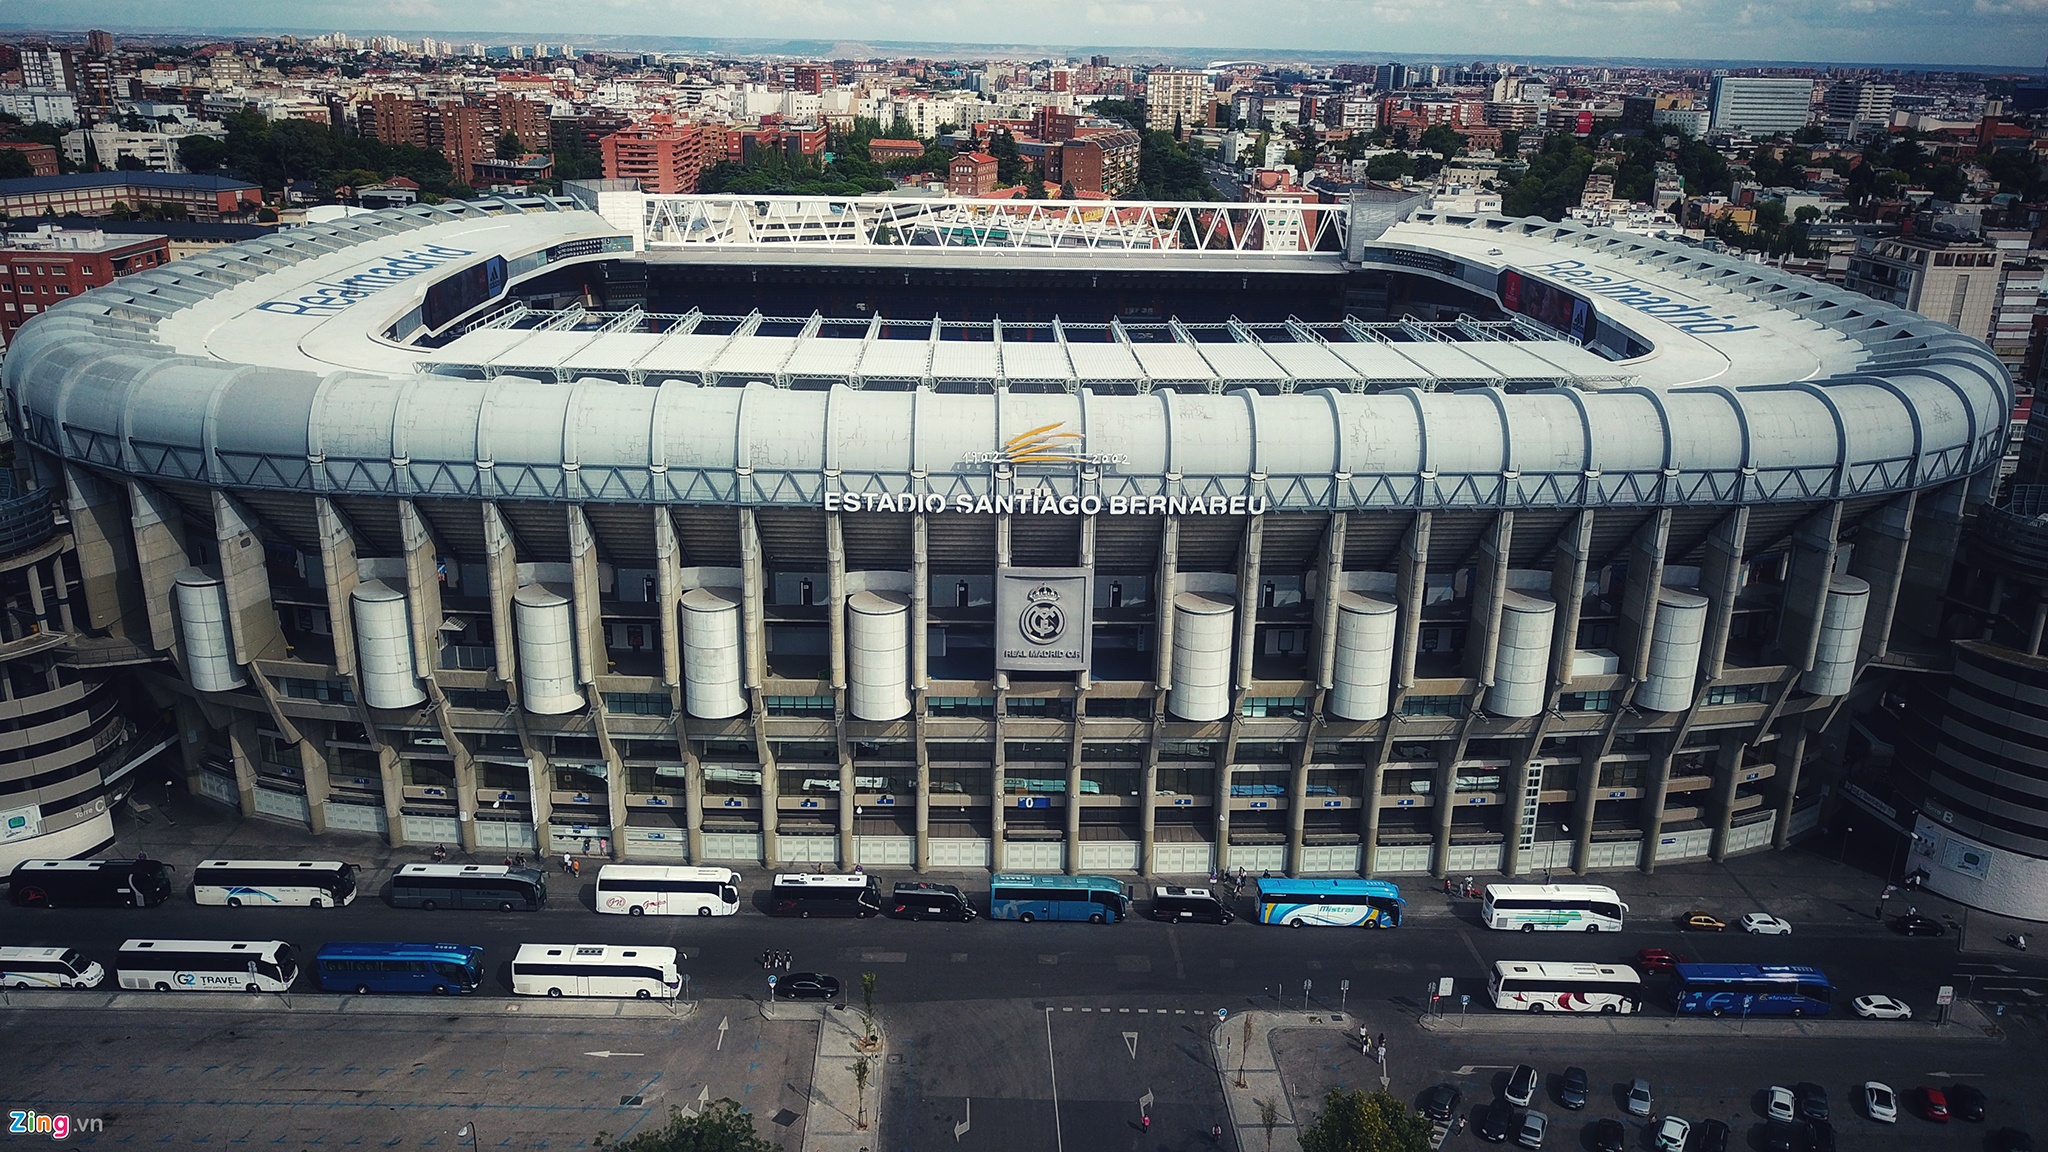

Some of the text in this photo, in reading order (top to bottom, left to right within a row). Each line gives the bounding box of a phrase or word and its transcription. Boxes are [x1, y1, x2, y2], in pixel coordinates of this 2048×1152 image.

[962, 451, 1000, 464] 1902
[1092, 453, 1130, 465] 2002
[824, 491, 1266, 516] ESTADIO SANTIAGO BERNABEU
[1003, 650, 1027, 658] REAL
[1029, 650, 1064, 658] MADRID
[74, 800, 105, 819] Torre C
[1925, 802, 1954, 824] Torre B
[1320, 905, 1355, 913] Mistral
[177, 974, 241, 986] G2 TRAVEL
